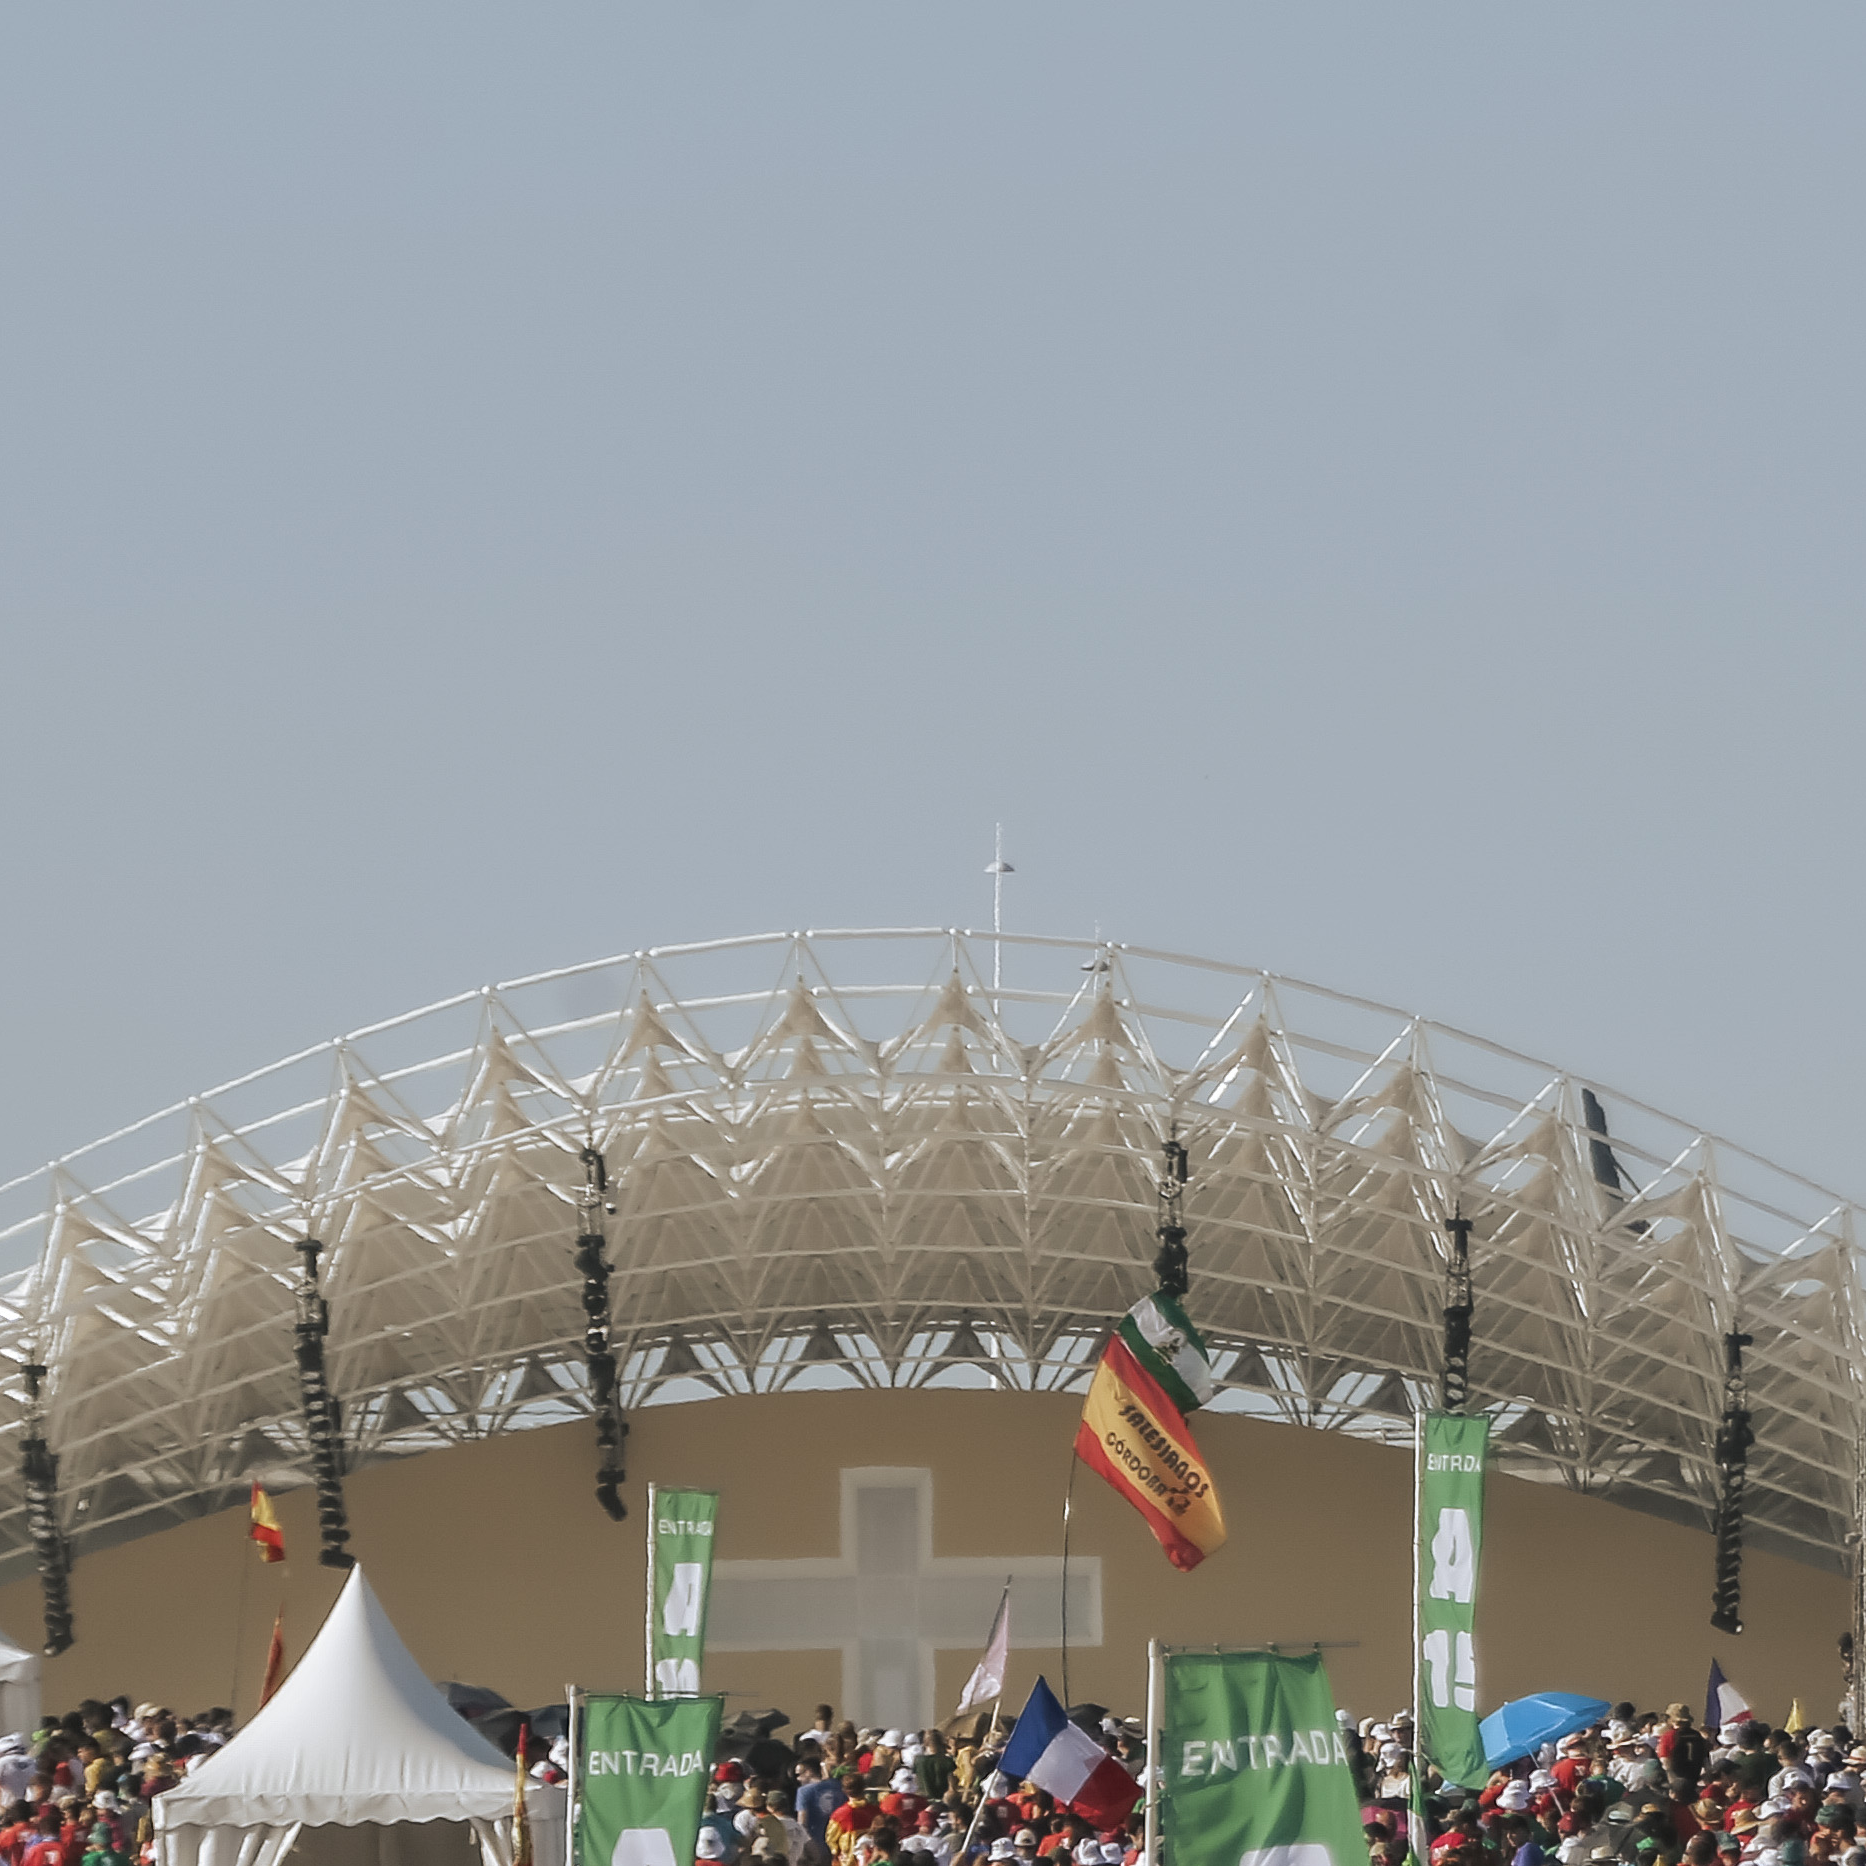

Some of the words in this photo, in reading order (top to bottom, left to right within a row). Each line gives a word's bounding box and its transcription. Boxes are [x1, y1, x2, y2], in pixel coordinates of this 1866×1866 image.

[1119, 1405, 1208, 1498] SALESIANOS
[1430, 1508, 1474, 1603] A
[664, 1563, 701, 1636] A
[589, 1750, 704, 1777] ENTRADA
[1181, 1730, 1349, 1777] ENTRADA
